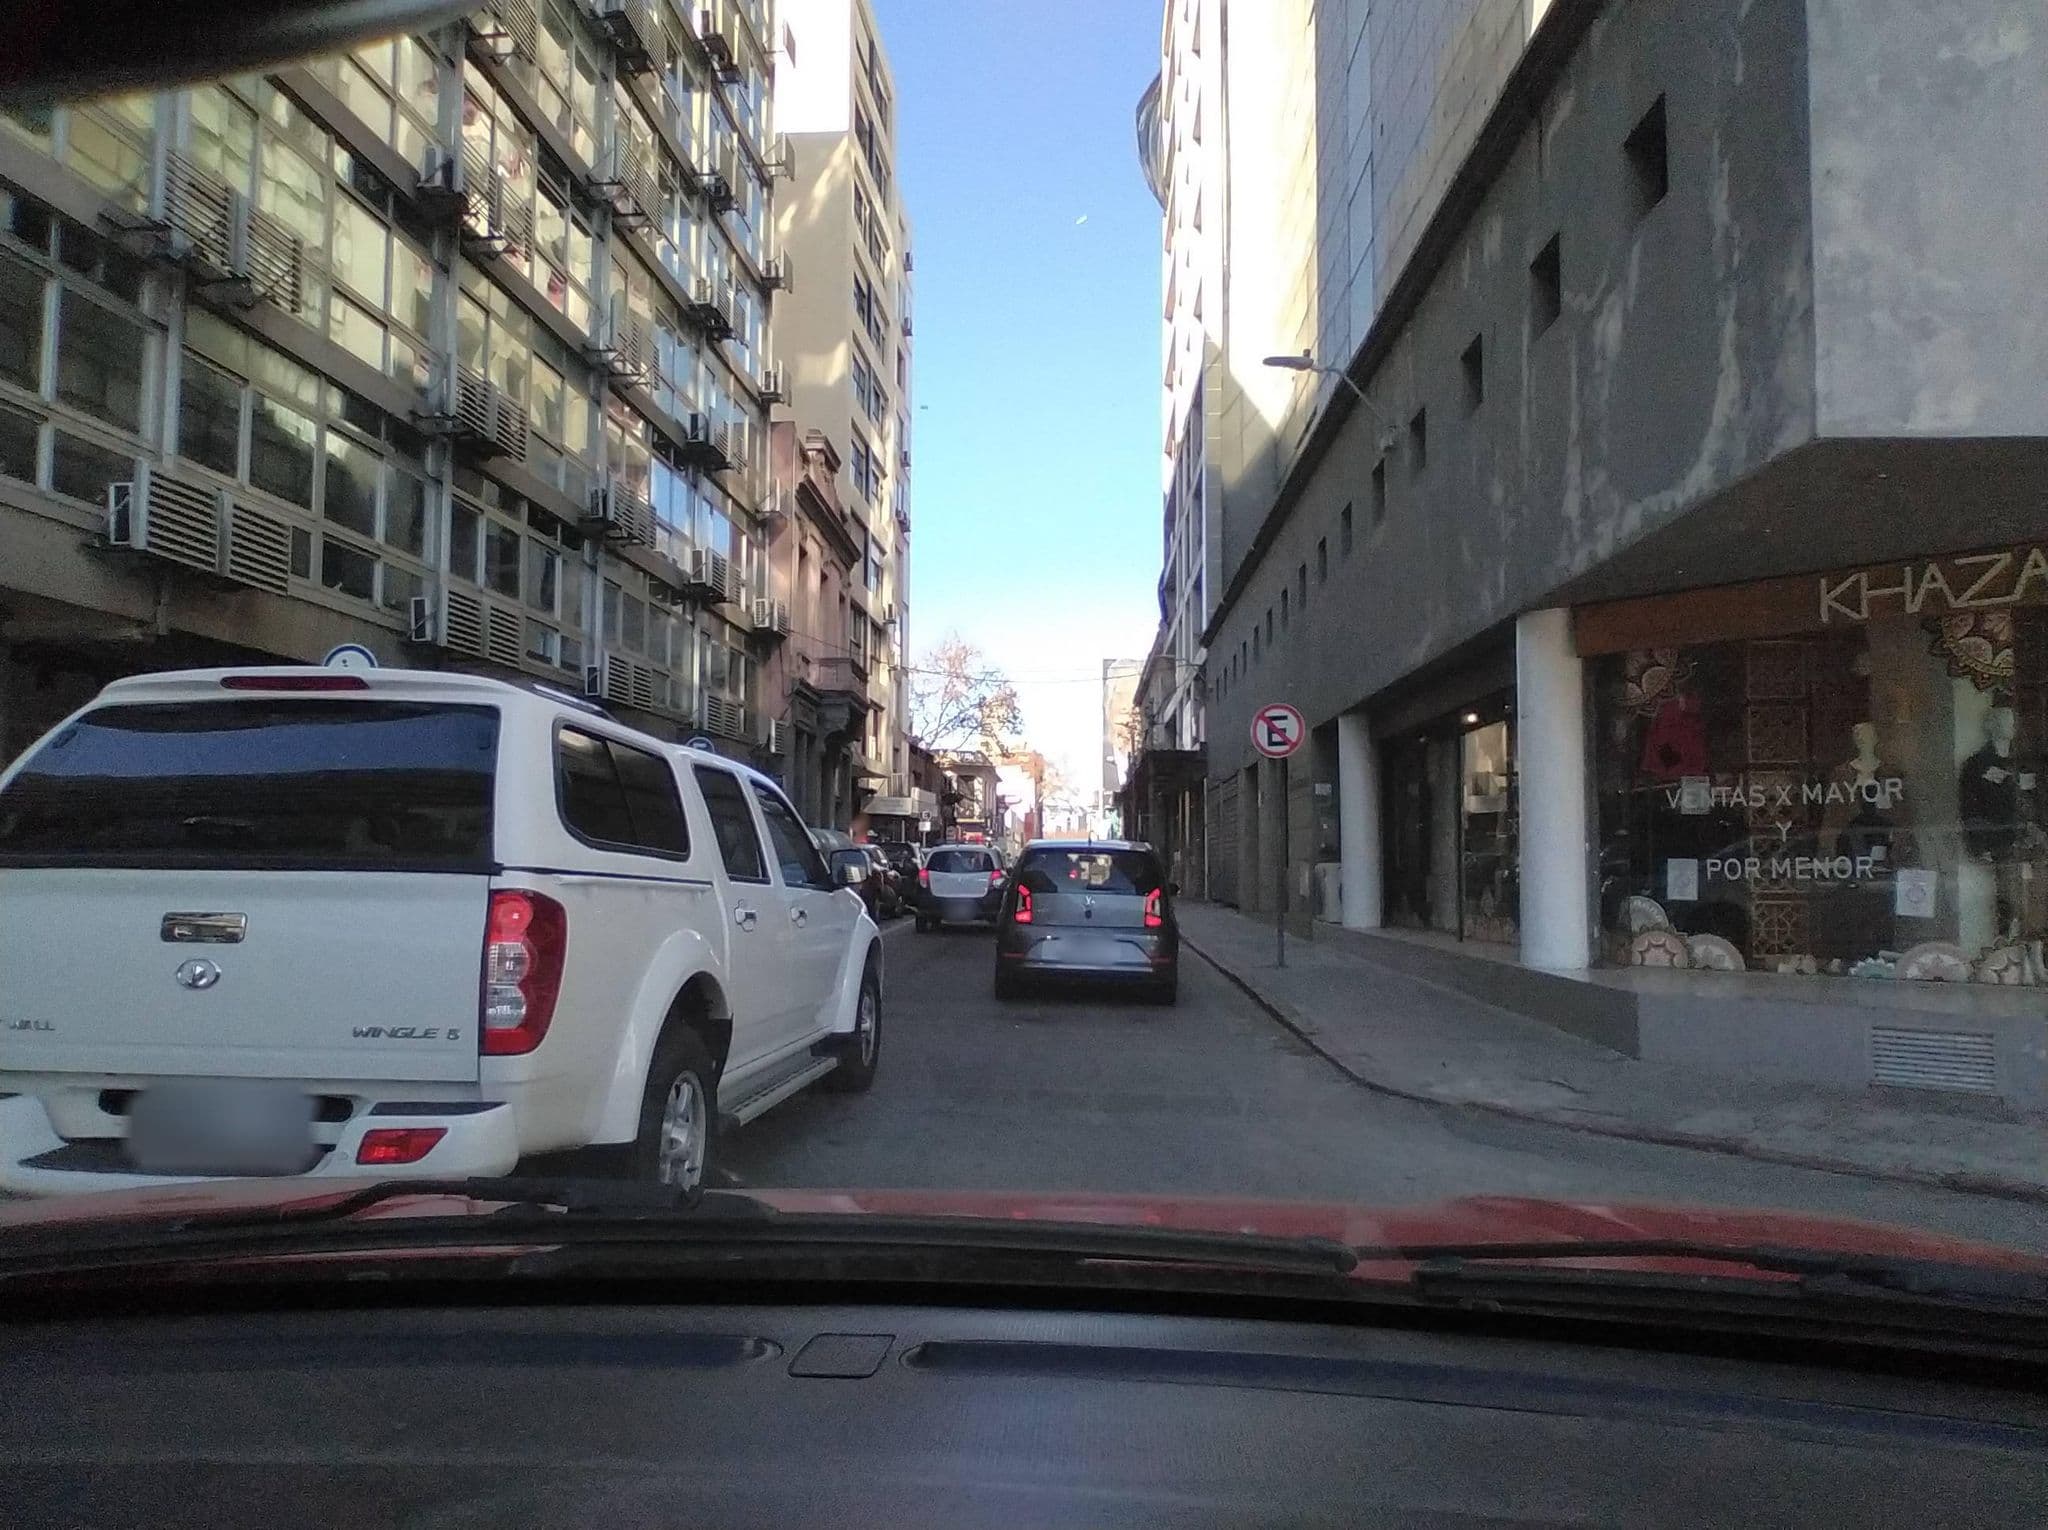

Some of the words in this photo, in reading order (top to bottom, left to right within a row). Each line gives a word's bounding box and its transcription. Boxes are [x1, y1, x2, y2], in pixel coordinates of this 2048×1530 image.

[1266, 715, 1290, 747] E
[1775, 784, 1793, 807] X
[1801, 777, 1904, 805] MAYOR
[1775, 820, 1793, 843] Y
[1706, 857, 1762, 881] POR
[1771, 854, 1875, 880] MENOR
[352, 1026, 441, 1040] WINGLE
